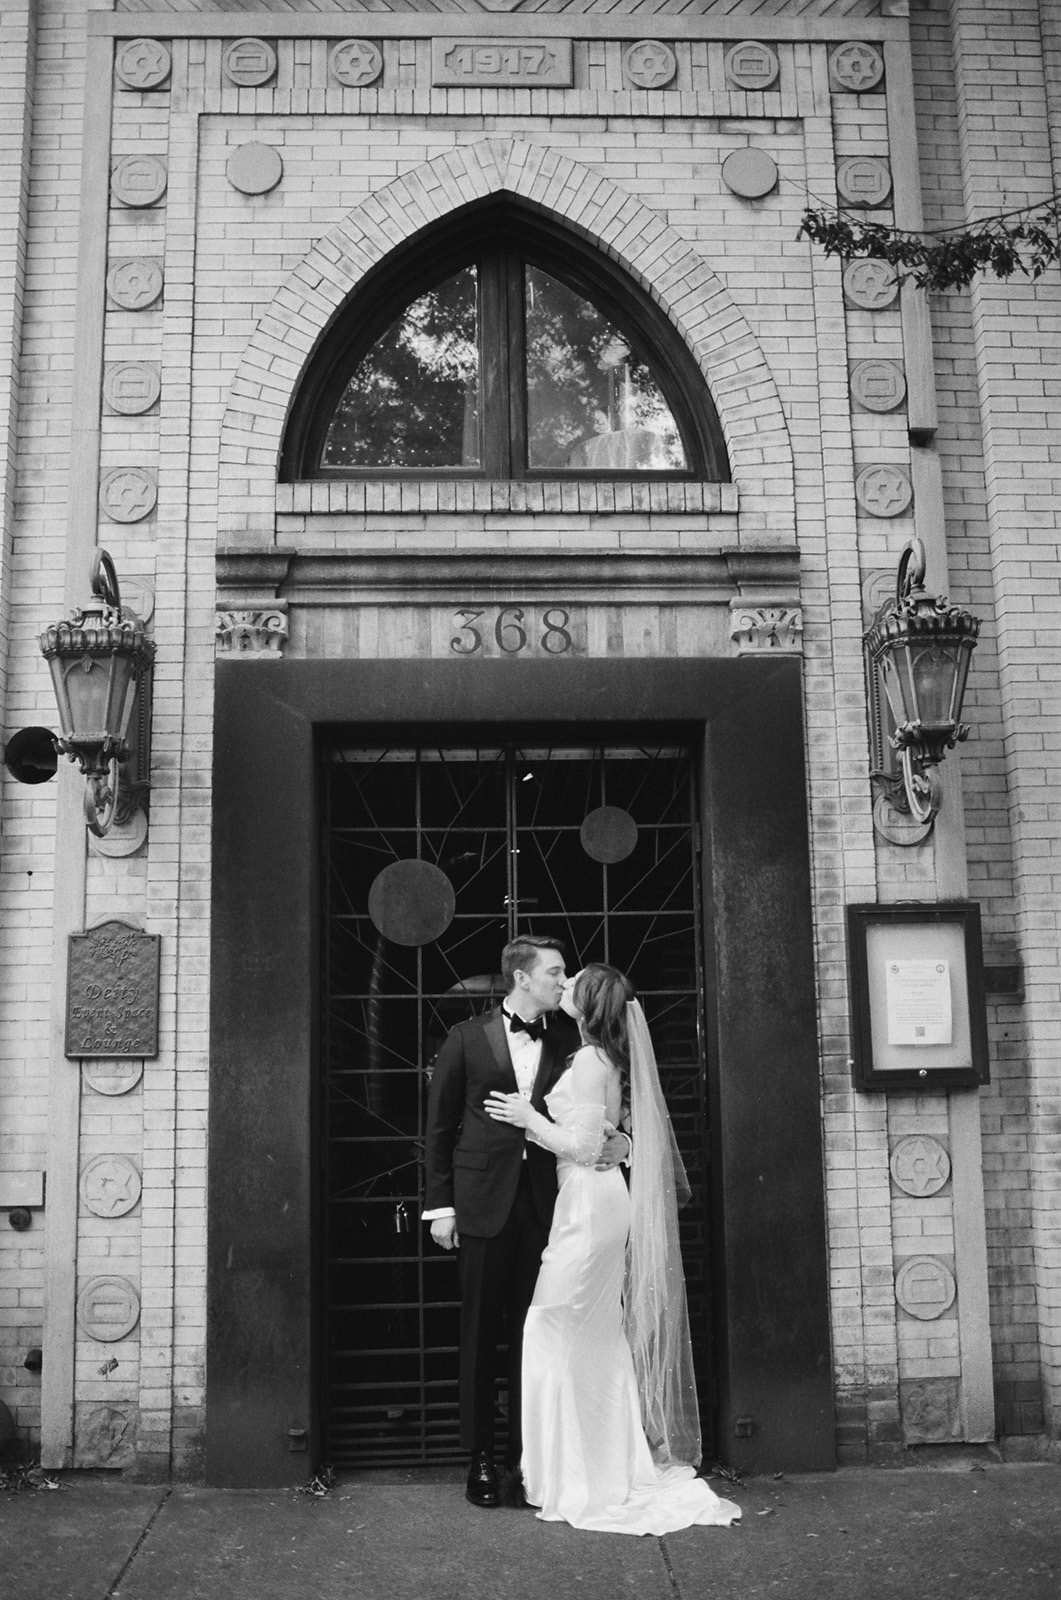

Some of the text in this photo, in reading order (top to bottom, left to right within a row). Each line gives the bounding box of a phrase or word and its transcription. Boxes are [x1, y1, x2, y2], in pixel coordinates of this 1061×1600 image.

[458, 47, 545, 75] 1917
[450, 608, 572, 654] 368
[85, 983, 140, 1006] Deity
[72, 1005, 154, 1022] Event Space
[104, 1020, 118, 1035] &
[80, 1035, 141, 1053] Lounge
